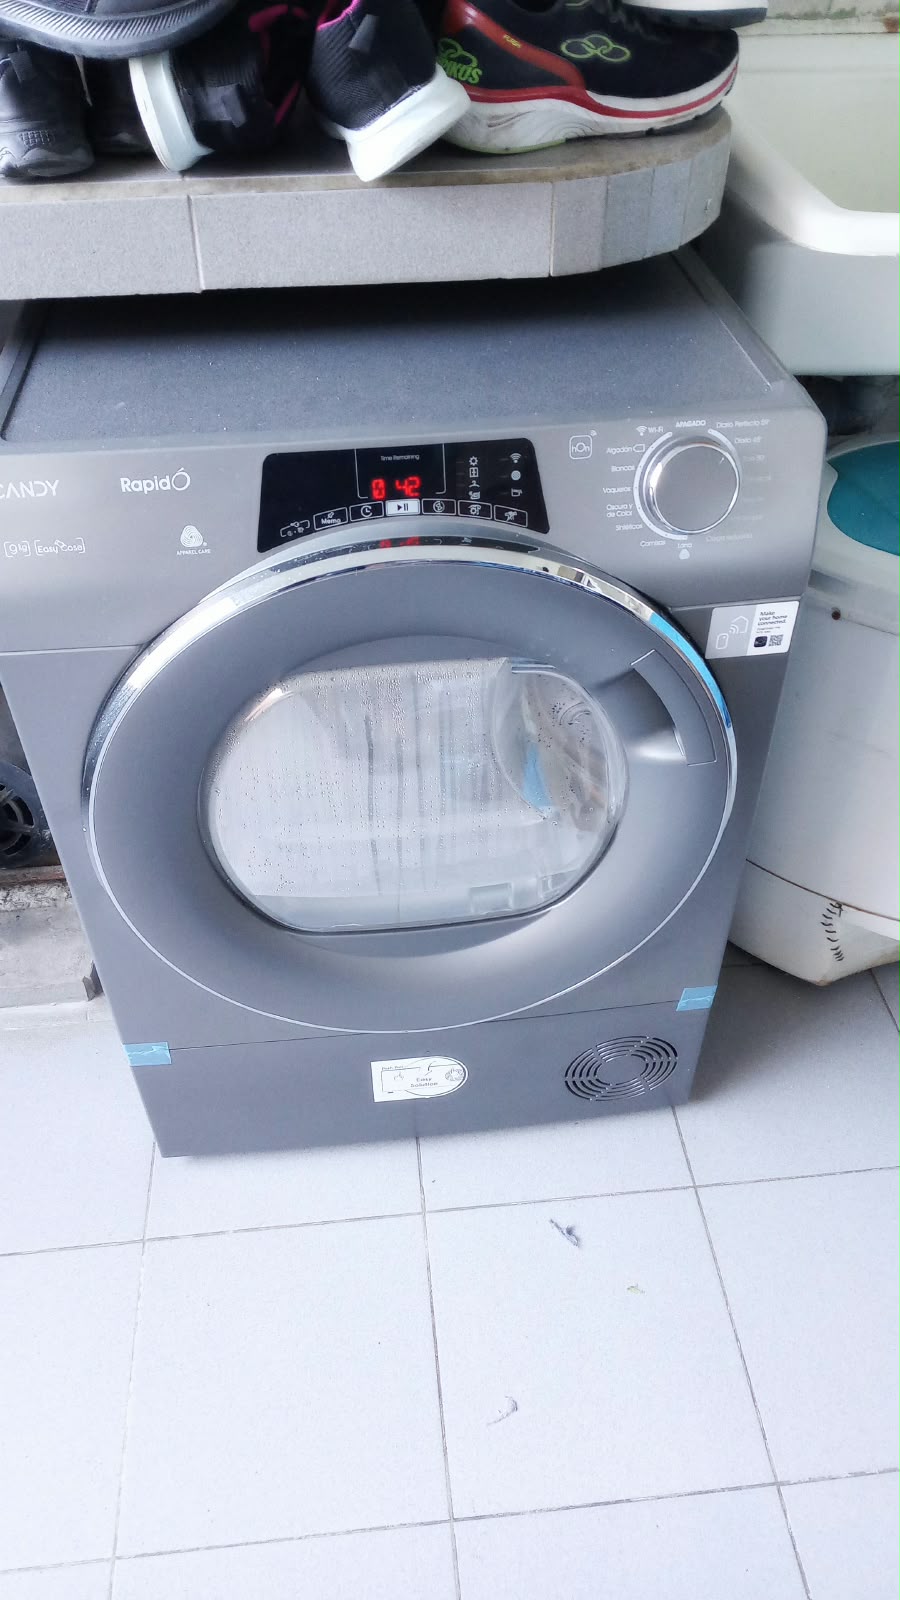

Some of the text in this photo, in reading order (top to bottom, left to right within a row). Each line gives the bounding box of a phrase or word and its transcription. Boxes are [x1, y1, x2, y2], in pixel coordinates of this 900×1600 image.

[675, 420, 706, 428] APAGADO
[571, 442, 590, 453] hOn
[119, 467, 191, 495] RapidÓ
[395, 476, 421, 497] 42
[603, 486, 632, 494] Vaqueros
[321, 517, 342, 525] Memo
[37, 545, 58, 554] Easy
